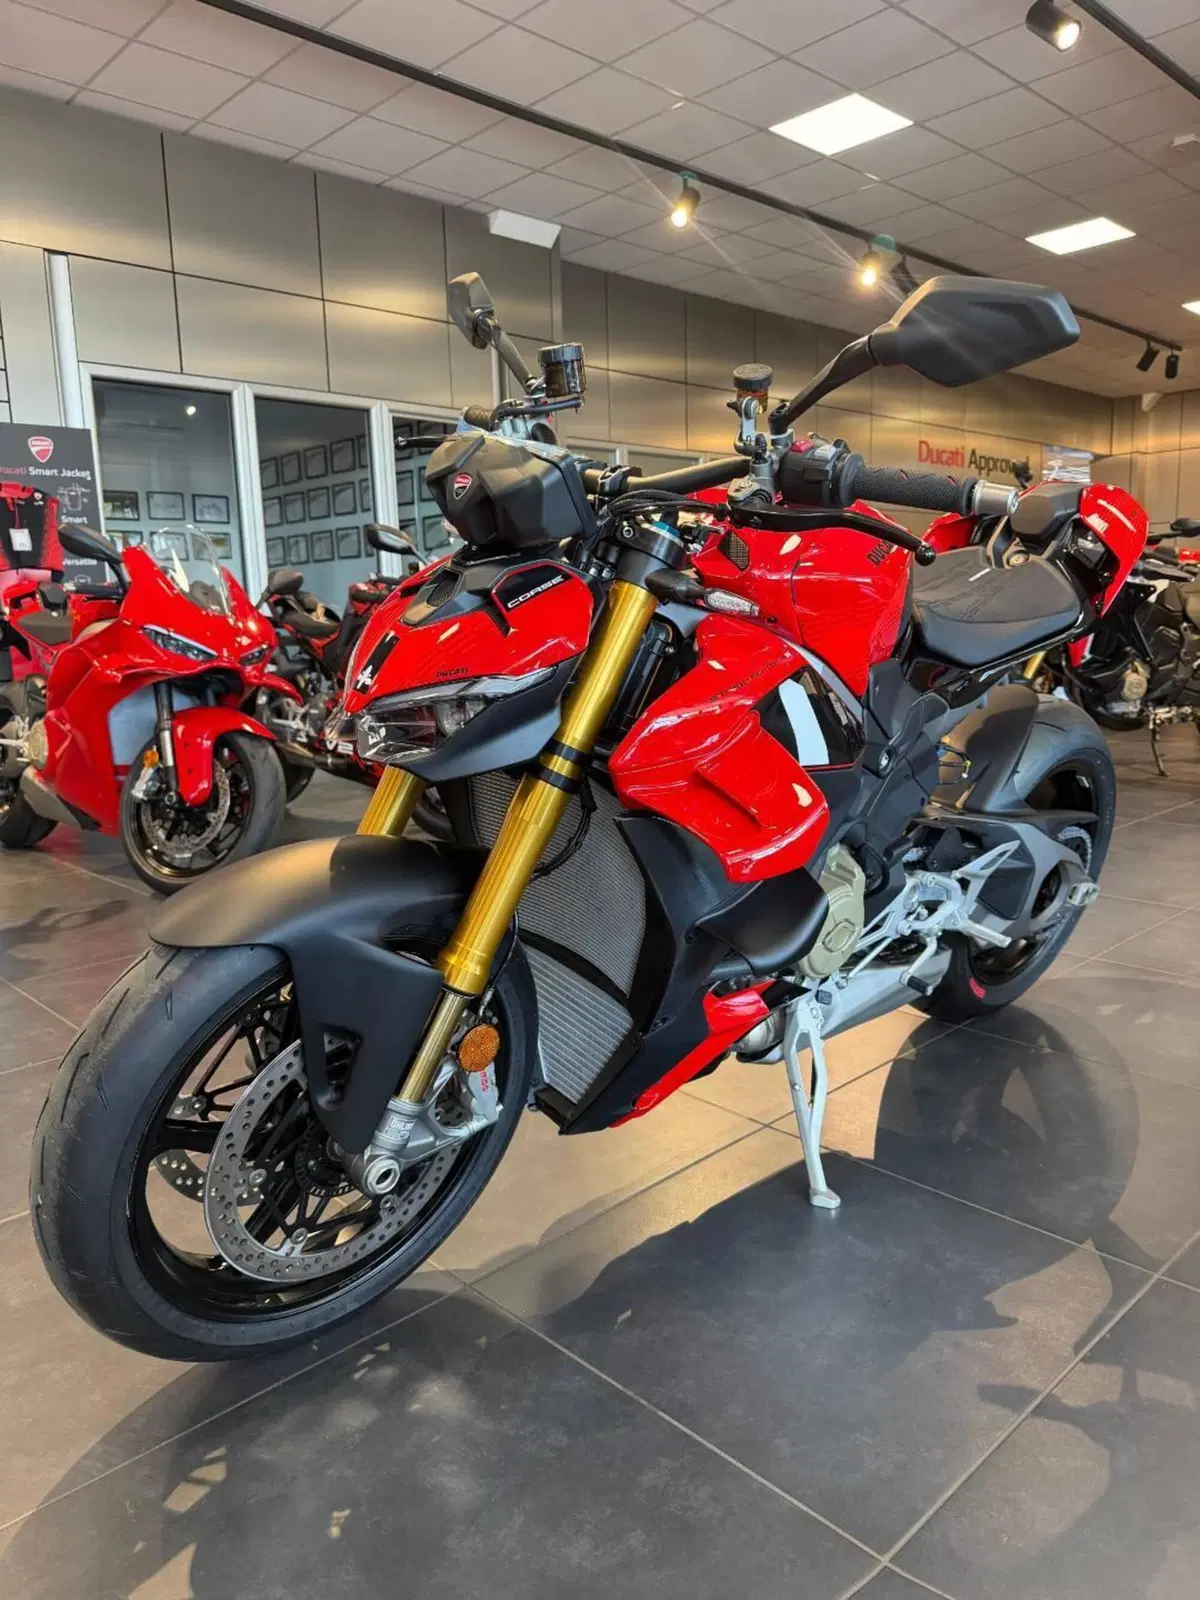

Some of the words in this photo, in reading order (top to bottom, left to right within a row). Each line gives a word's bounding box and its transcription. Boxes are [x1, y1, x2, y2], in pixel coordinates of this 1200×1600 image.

[918, 440, 965, 468] Ducati
[968, 449, 1030, 476] Approv
[0, 465, 26, 474] ucati
[28, 466, 59, 476] Smart
[60, 468, 91, 480] Jacket
[61, 515, 88, 524] Smart
[507, 574, 564, 608] CORSE
[436, 667, 469, 677] DUCATI
